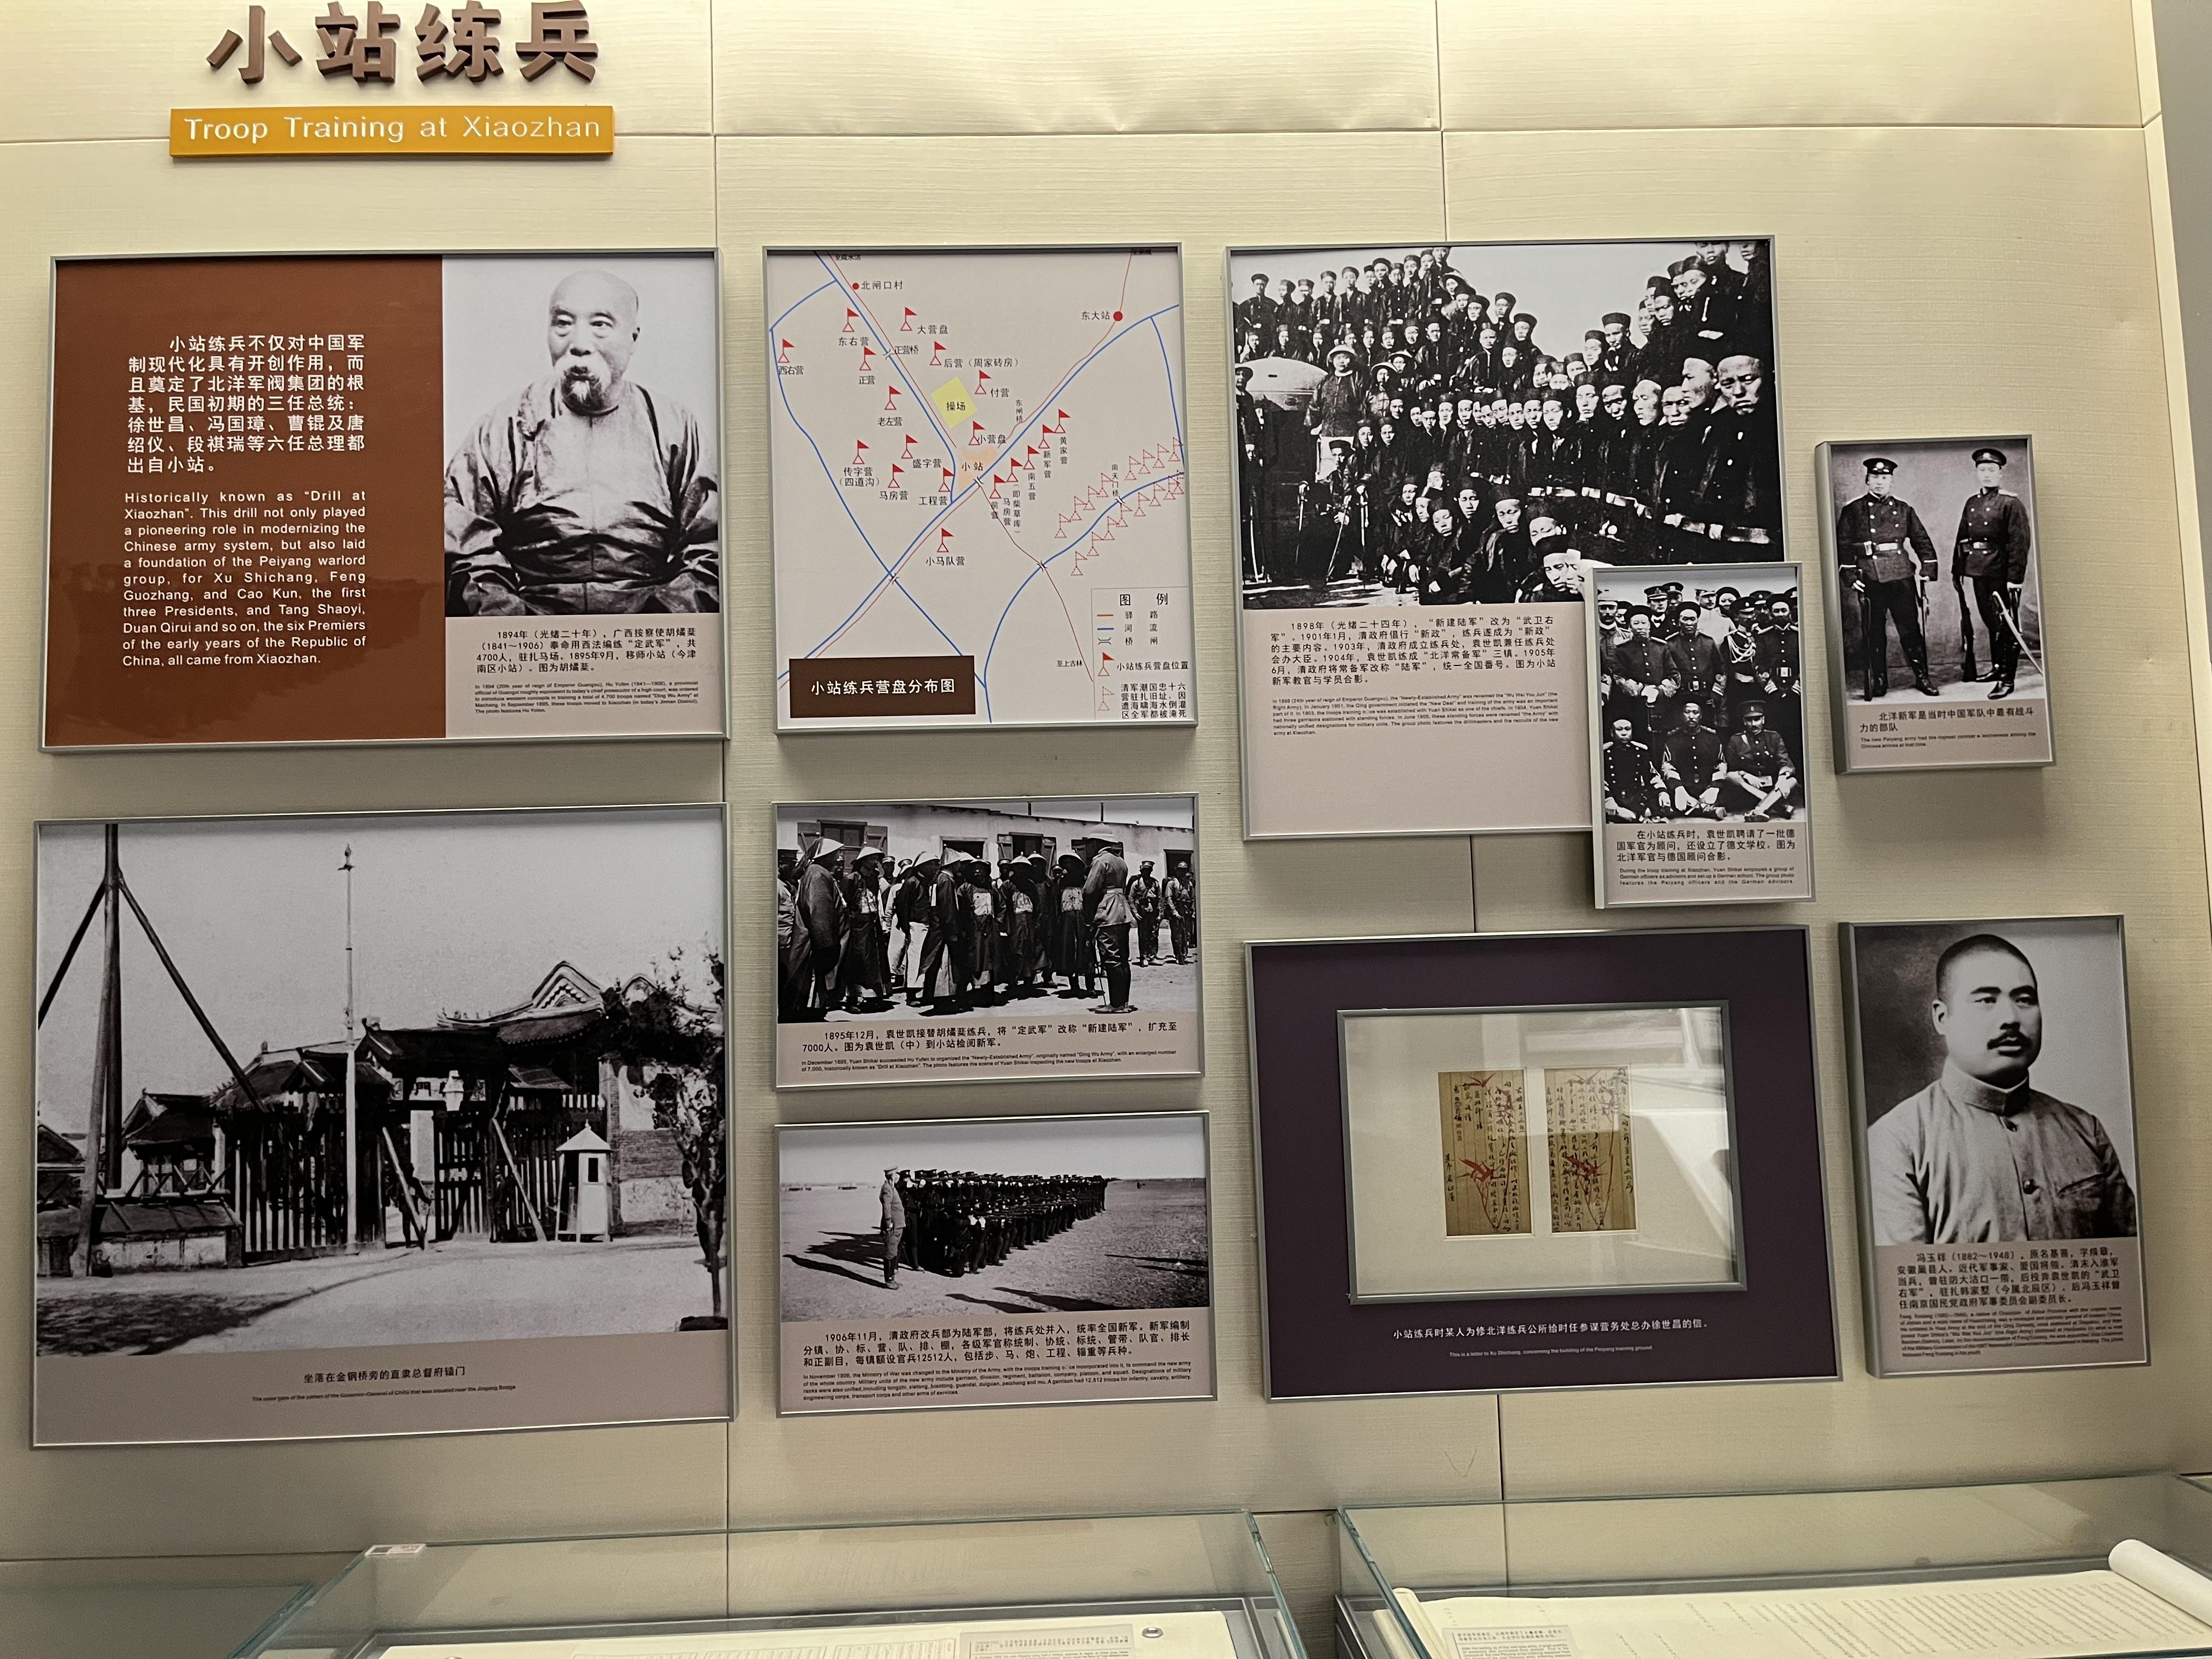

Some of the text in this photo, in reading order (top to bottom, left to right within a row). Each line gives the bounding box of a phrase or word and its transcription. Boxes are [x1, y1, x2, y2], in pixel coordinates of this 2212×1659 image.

[207, 1, 599, 84] 小站练兵
[184, 116, 599, 144] Troop Training at Xiaozhan
[861, 280, 903, 290] 北闸口村
[1081, 311, 1110, 320] 东大站
[917, 325, 948, 335] 大营盘
[170, 334, 365, 353] 小站练兵不仅对中国军
[838, 337, 870, 347] 东右营
[128, 354, 364, 373] 制现代化具有开创作用，而
[778, 365, 804, 375] 西右营
[128, 374, 364, 393] 且奠定了北洋军阀集团的根
[859, 375, 876, 385] 正营
[990, 387, 1009, 398] 付营
[128, 394, 353, 413] 基，民国初期的三任总统：
[946, 401, 966, 411] 操场
[127, 414, 364, 433] 徐世昌、冯国璋、曹锟及唐
[877, 416, 904, 427] 老左营
[127, 434, 365, 454] 绍仪、段祺瑞等六任总理都
[978, 435, 1006, 444] 小营盘
[1059, 437, 1068, 465] 黄家营
[128, 456, 214, 473] 出自小站。
[962, 462, 984, 472] 小站
[1043, 450, 1052, 479] 新军营
[843, 467, 873, 477] 传字营
[1028, 473, 1036, 500] 南五营
[125, 492, 208, 503] Historically
[220, 492, 265, 502] known
[276, 493, 293, 501] as
[352, 490, 365, 500] at
[878, 490, 909, 500] 马房营
[918, 496, 948, 506] 工程营
[200, 507, 227, 518] This
[234, 507, 257, 518] drill
[264, 507, 284, 518] not
[290, 507, 317, 517] only
[323, 506, 365, 517] played
[124, 522, 365, 537] a pioneering role in modernizing the
[124, 539, 365, 552] Chinese army system, but also laid
[124, 555, 365, 568] a foundation of the Peiyang warlord
[926, 556, 965, 566] 小马队营
[123, 571, 365, 586] group, for Xu Shichang, Feng
[123, 587, 366, 601] Guozhang, and Cao Kun, the first
[123, 603, 365, 617] three Presidents, and Tang Shaoyi,
[123, 620, 365, 633] Duan Qirui and so on, the six Premiers
[123, 636, 366, 650] of the early years of the Republic of
[123, 653, 321, 666] China, all came from Xiaozhan.
[1117, 661, 1188, 671] 小站练兵营盘位置
[811, 679, 955, 696] 小站练兵营盘分布图
